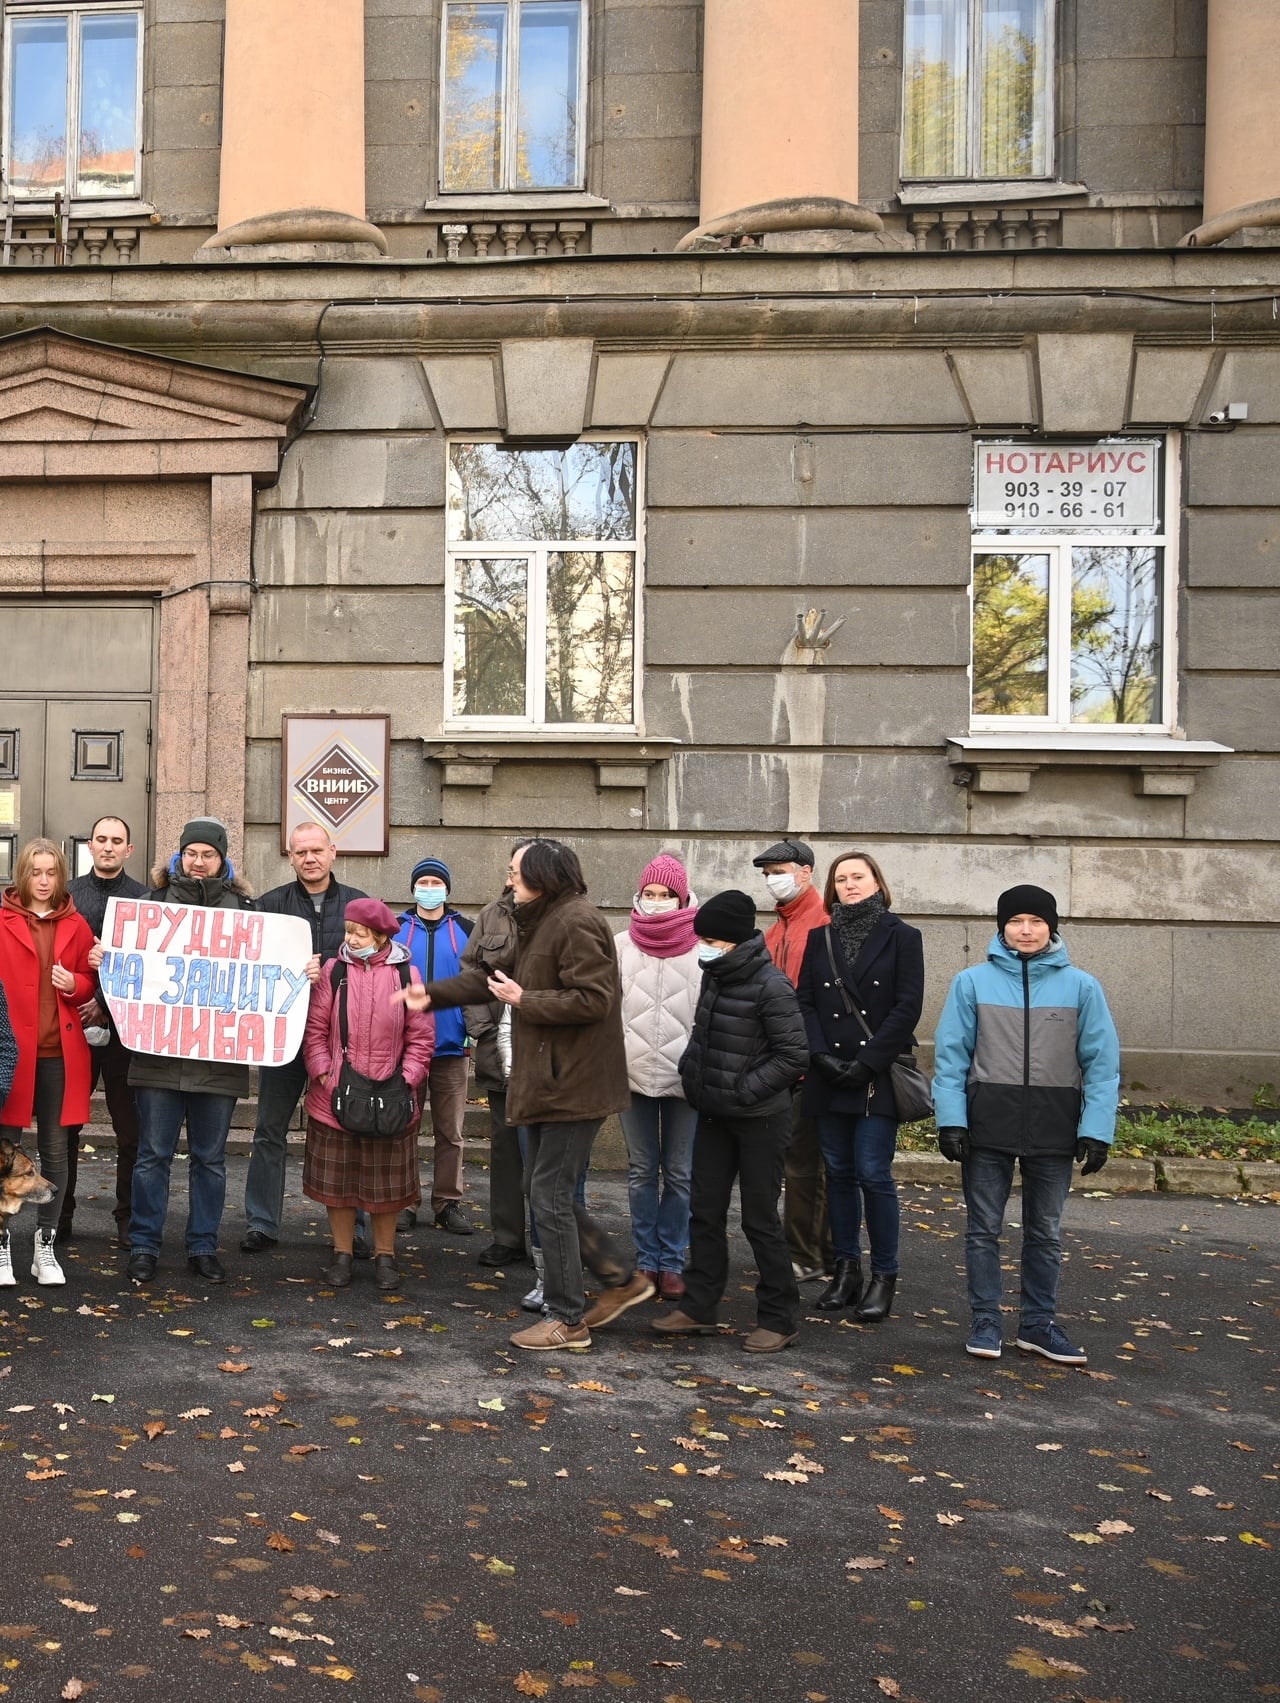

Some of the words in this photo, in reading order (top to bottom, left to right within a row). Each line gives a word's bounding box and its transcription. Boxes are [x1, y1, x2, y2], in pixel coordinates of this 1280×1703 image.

[986, 452, 1146, 474] НОТАРИУС
[1004, 481, 1040, 497] 903
[1060, 481, 1083, 497] 39
[1103, 481, 1127, 497] 07
[1004, 502, 1040, 518] 910
[1060, 502, 1083, 518] 66
[1103, 502, 1125, 518] 61
[322, 767, 352, 775] БИЗНЕС
[306, 779, 368, 793] ВНИИБ
[324, 797, 349, 805] ЦЕНТР
[111, 901, 265, 961] ГРУДЬЮ
[100, 950, 145, 1000] НА
[159, 956, 309, 1014] ЗАЩИТУ
